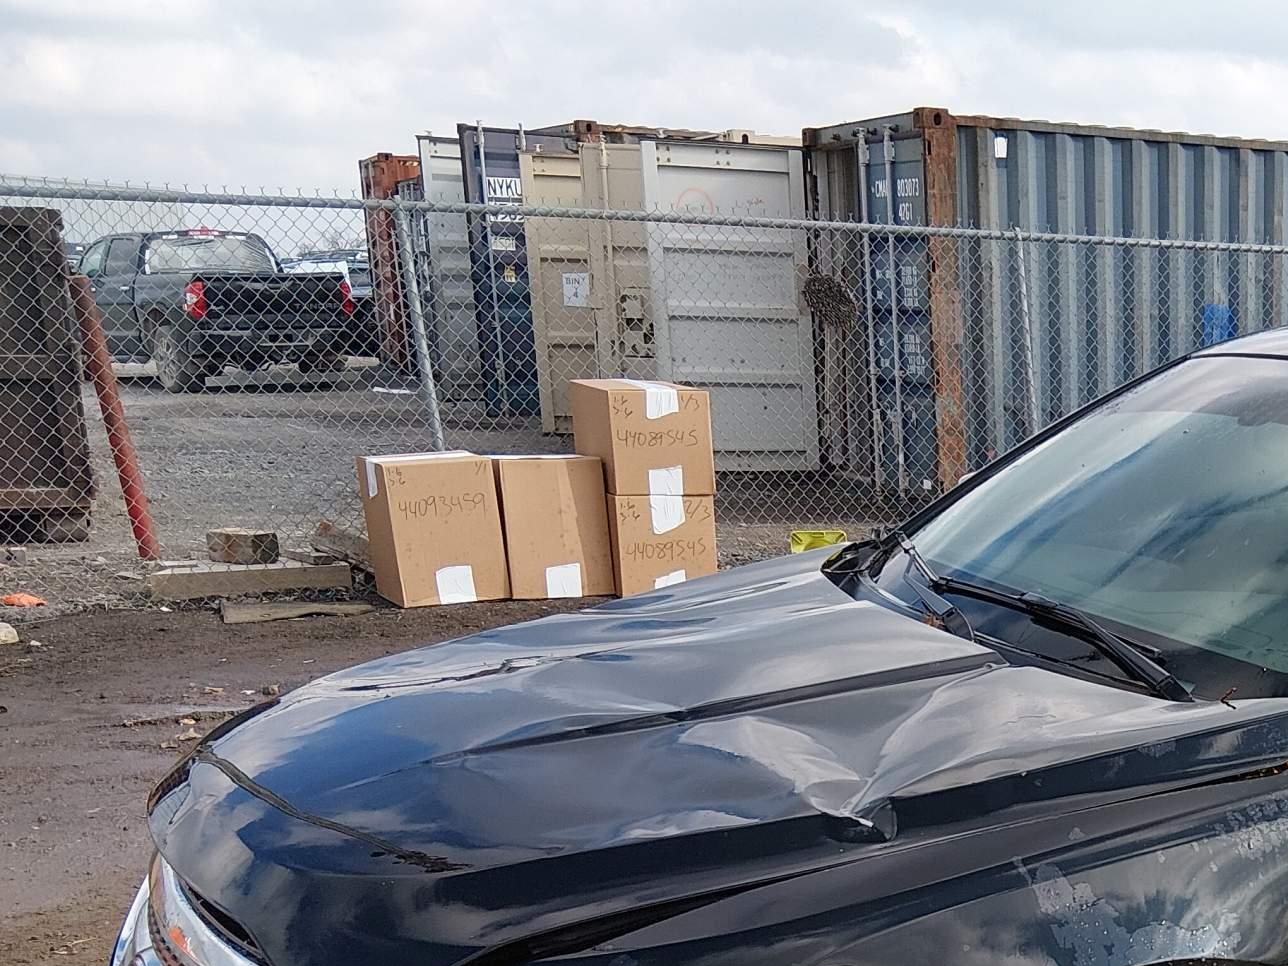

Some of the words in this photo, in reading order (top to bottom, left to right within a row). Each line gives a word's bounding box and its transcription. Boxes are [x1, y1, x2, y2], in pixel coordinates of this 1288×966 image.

[616, 429, 699, 448] 44089545
[398, 492, 487, 520] 44093459
[624, 538, 706, 561] 44089545
